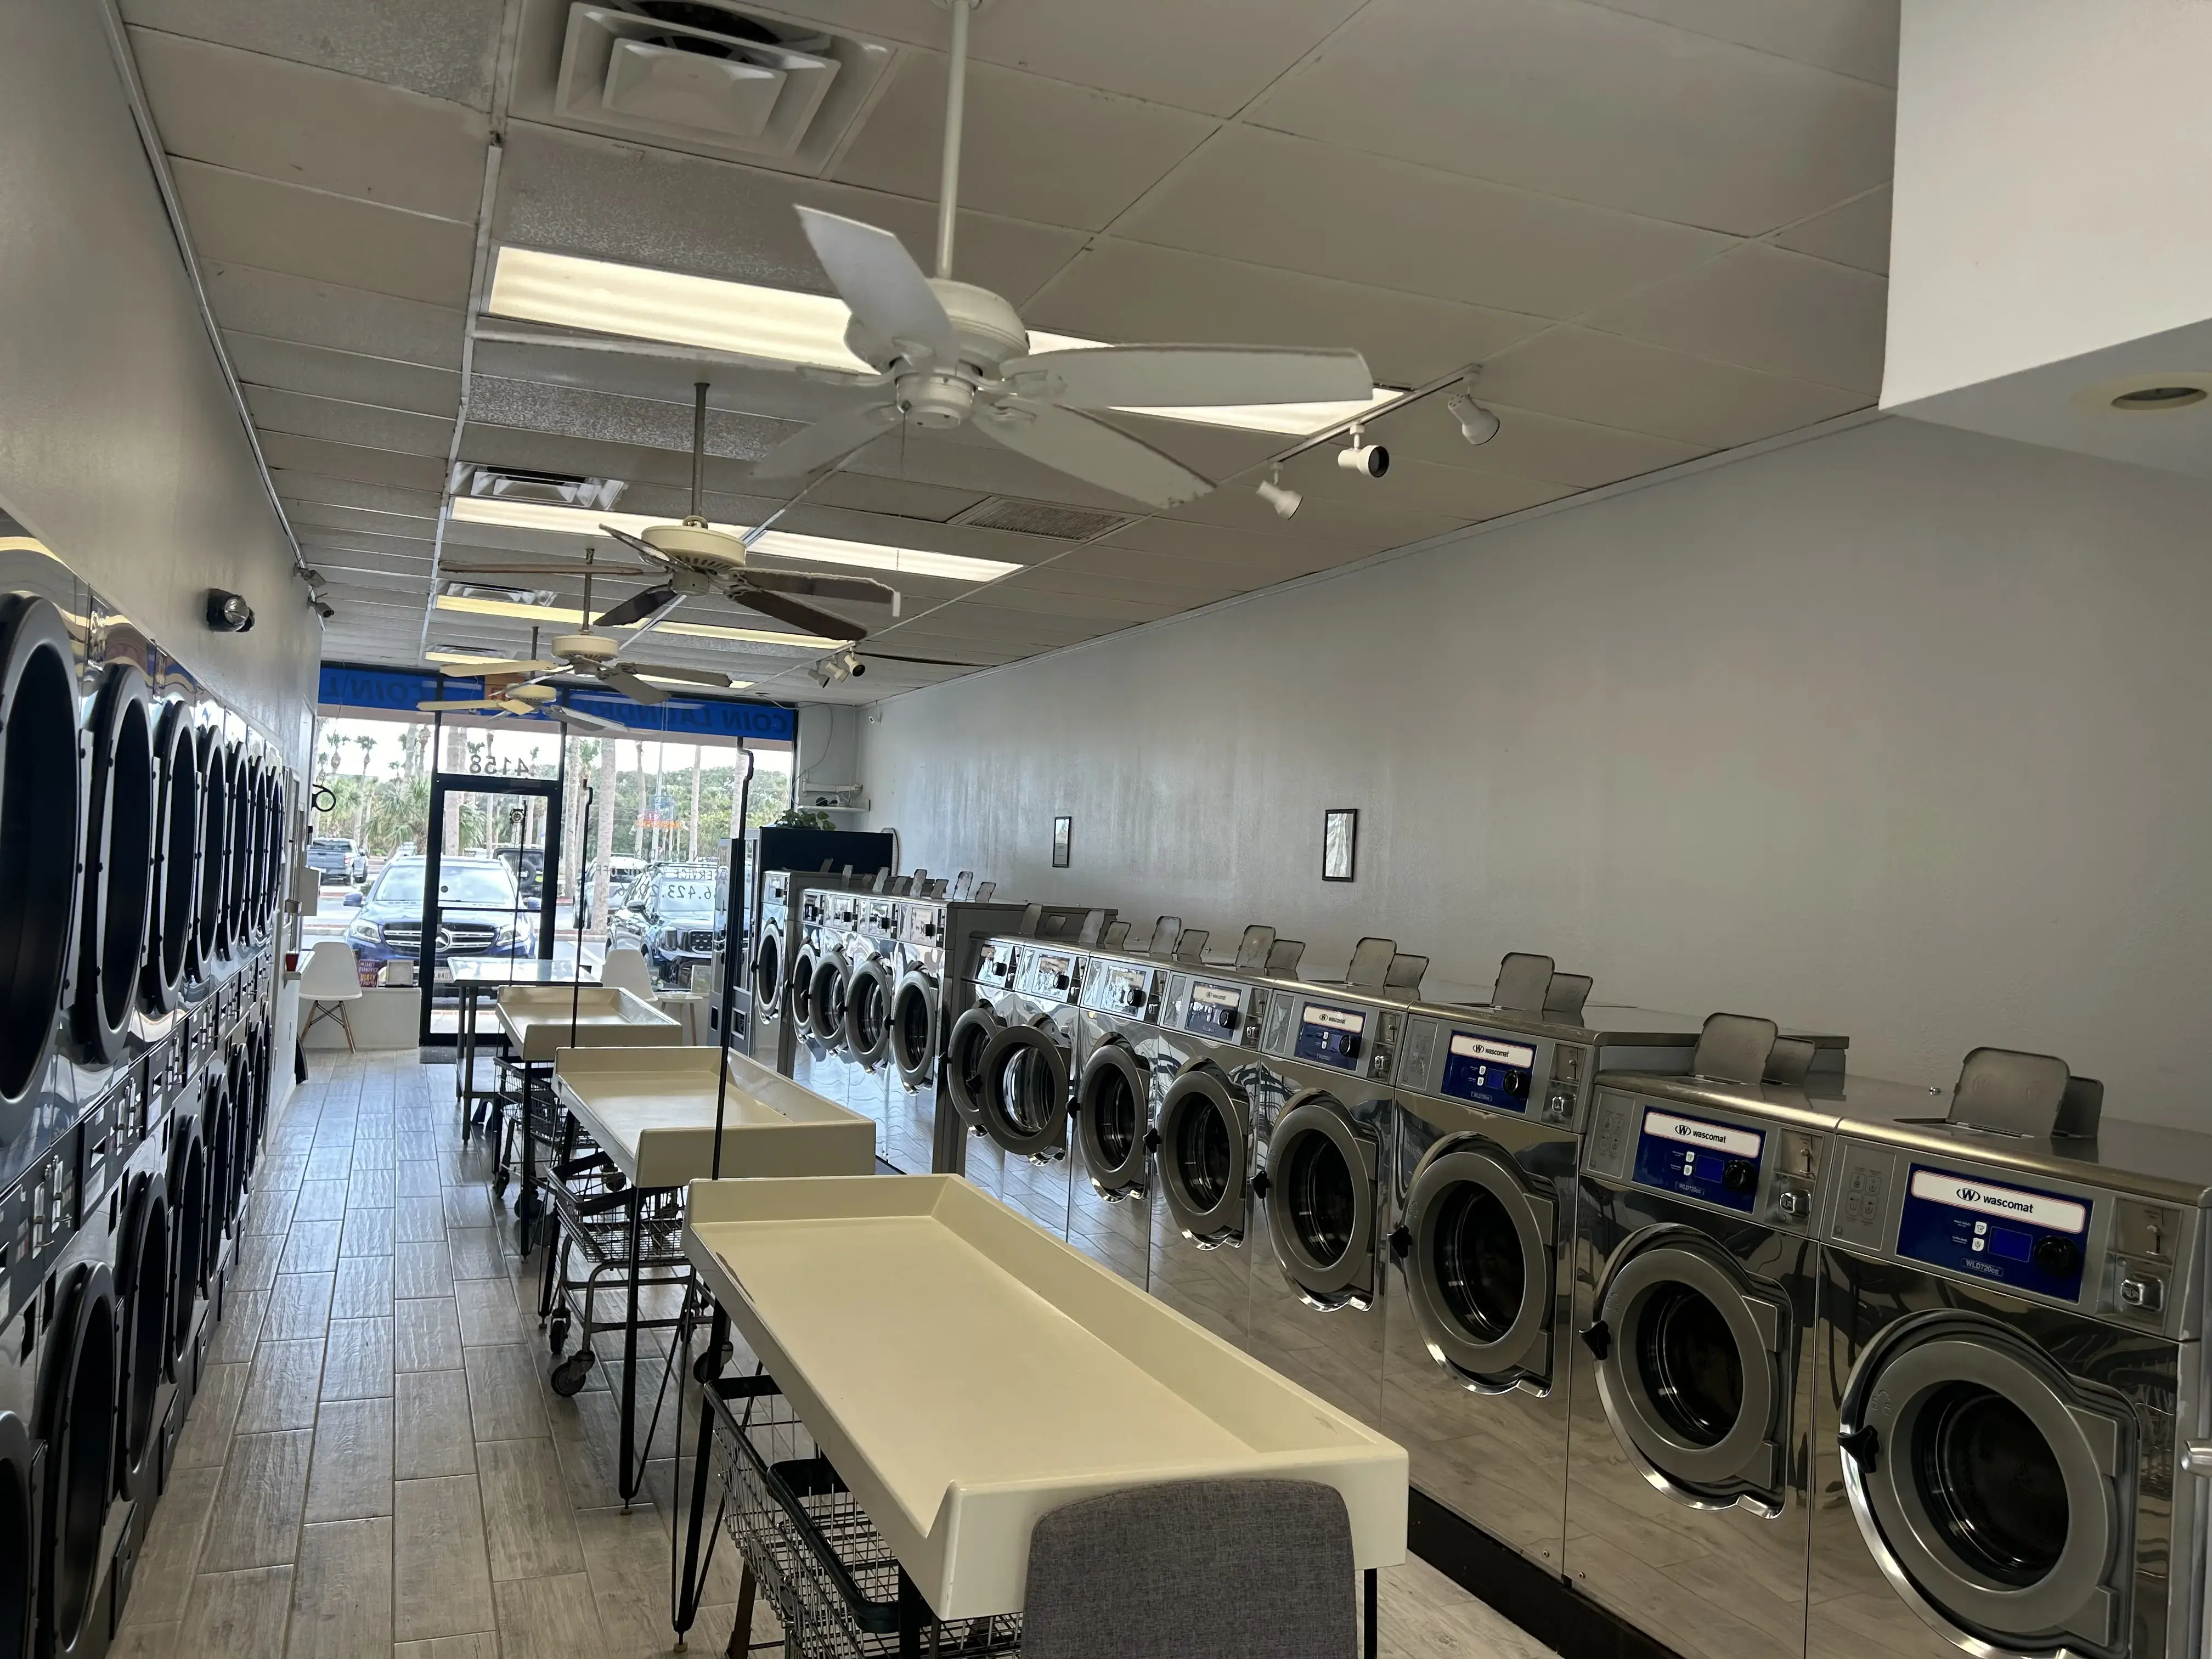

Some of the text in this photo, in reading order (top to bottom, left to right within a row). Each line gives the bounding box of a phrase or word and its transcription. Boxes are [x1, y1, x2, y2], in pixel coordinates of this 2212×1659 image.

[1485, 1047, 1509, 1058] wascomat
[1692, 1130, 1726, 1143] wascomat
[1983, 1196, 2034, 1214] wascomat
